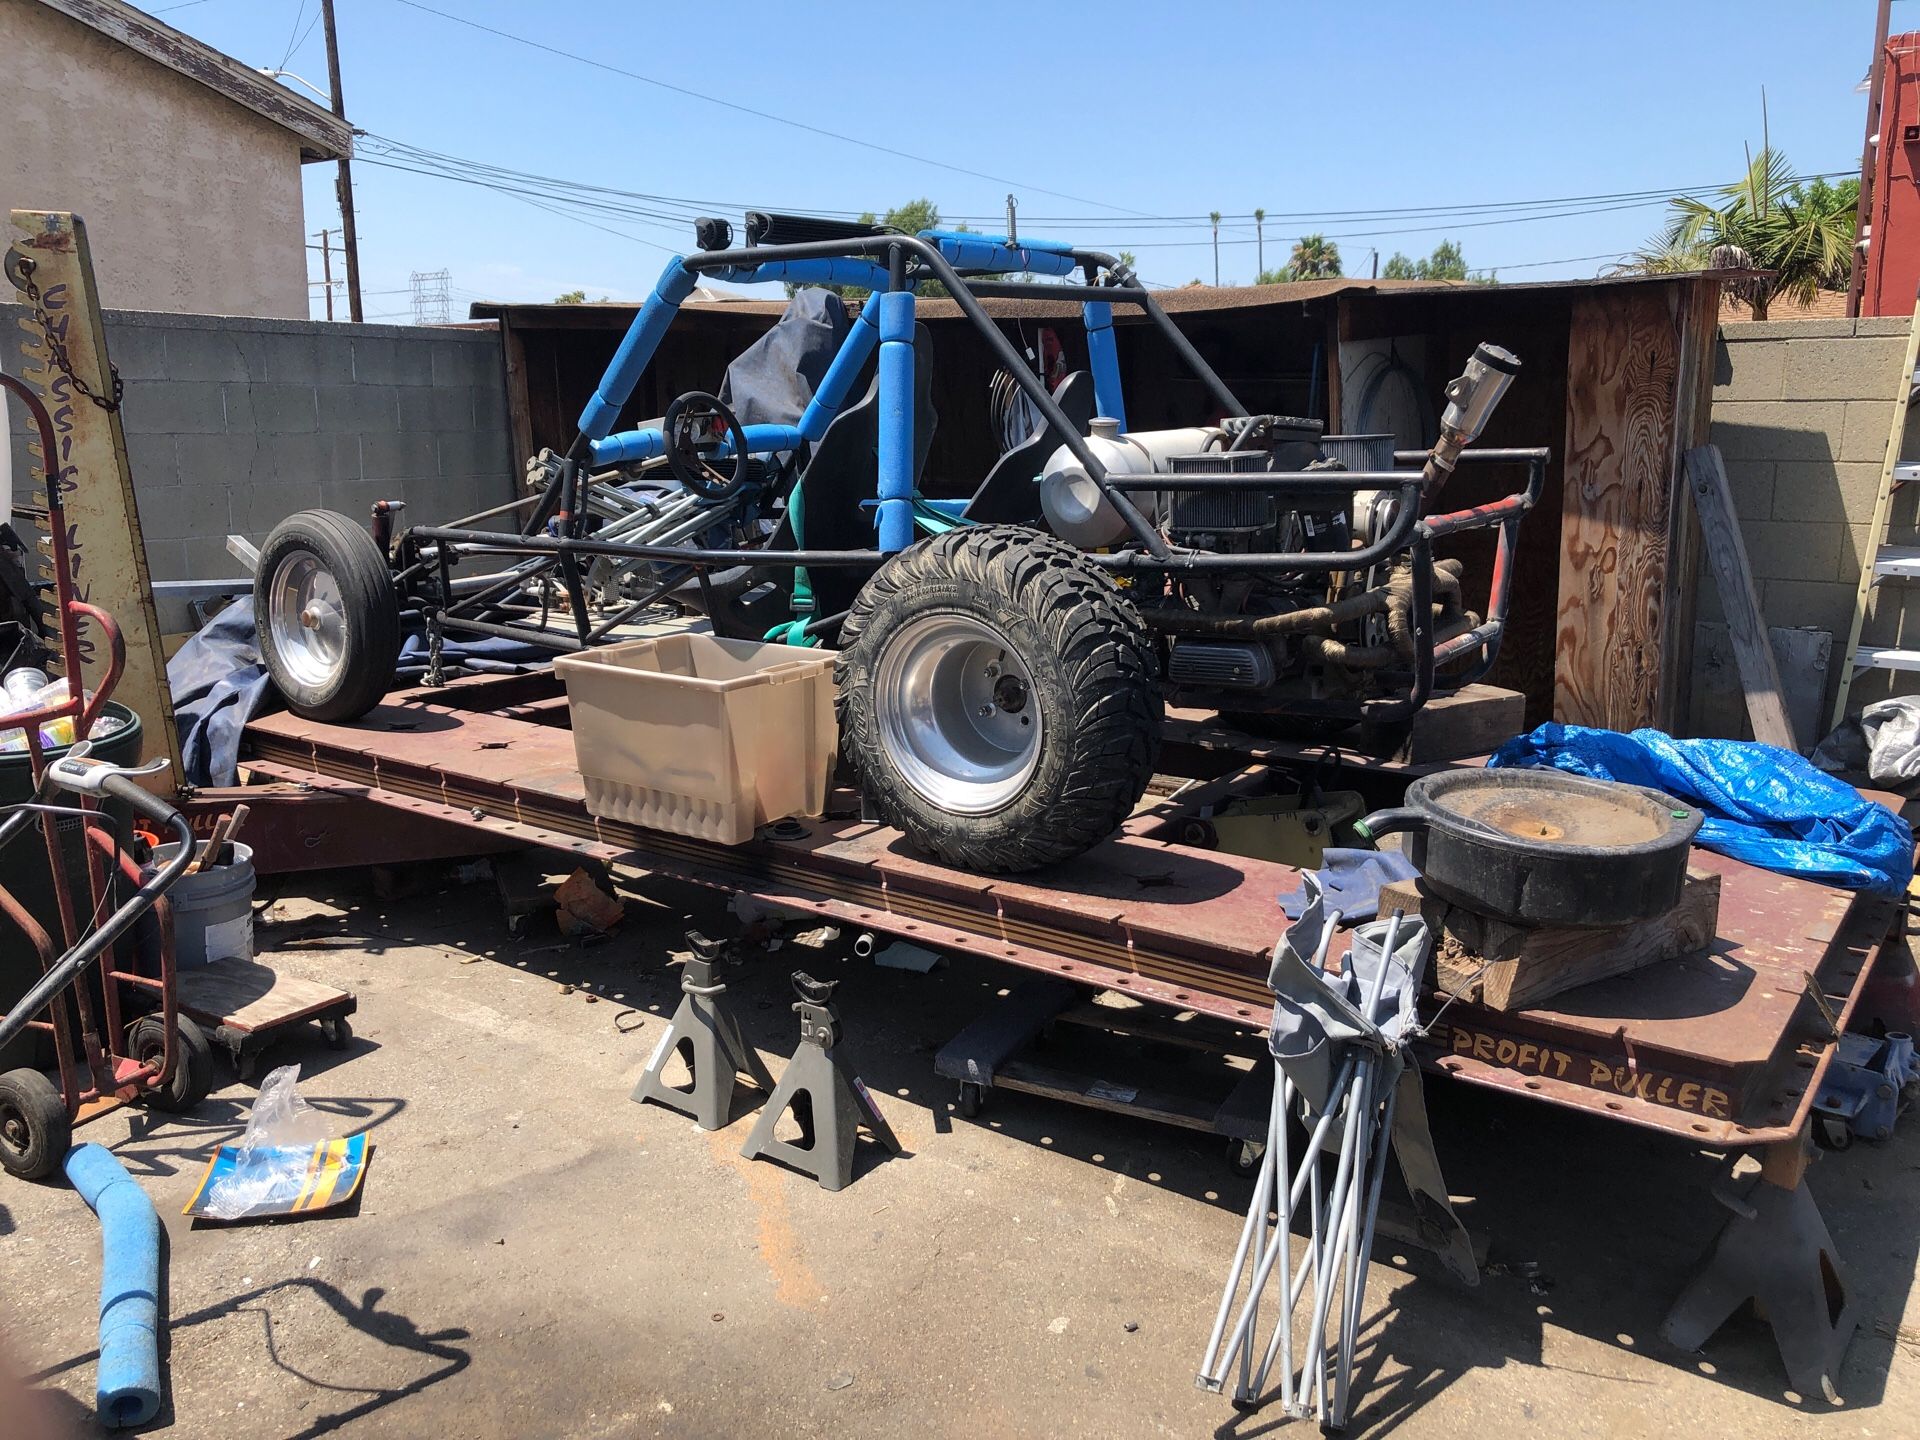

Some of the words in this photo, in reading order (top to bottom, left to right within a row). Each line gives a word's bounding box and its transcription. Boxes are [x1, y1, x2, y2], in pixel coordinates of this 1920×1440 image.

[43, 284, 79, 492] CHASSIS
[1453, 1027, 1572, 1077] PROFIT
[1589, 1059, 1729, 1117] PULLER
